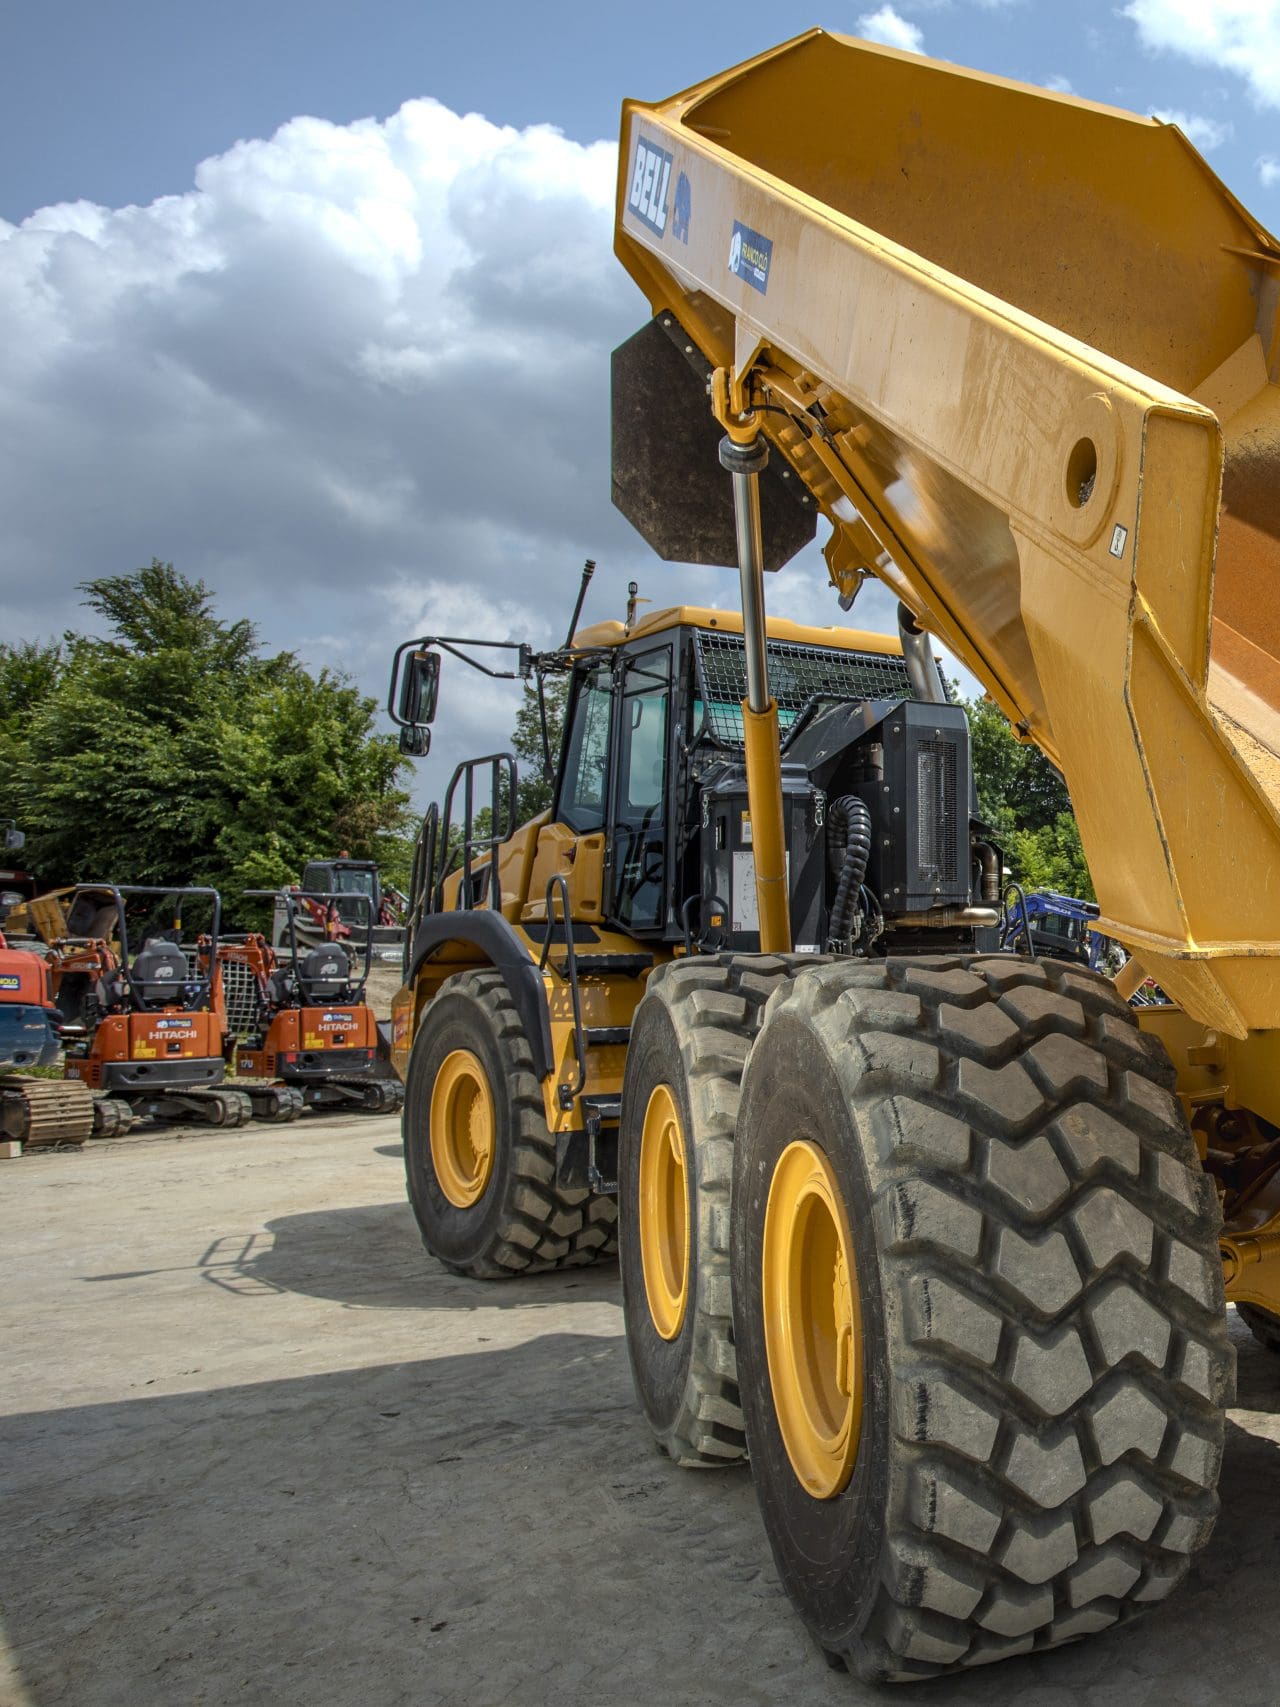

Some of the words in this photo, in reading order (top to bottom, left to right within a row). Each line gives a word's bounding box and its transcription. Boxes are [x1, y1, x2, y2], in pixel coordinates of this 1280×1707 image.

[630, 144, 671, 230] BELL
[318, 1023, 359, 1031] HITACHI
[148, 1030, 198, 1040] HITACHI
